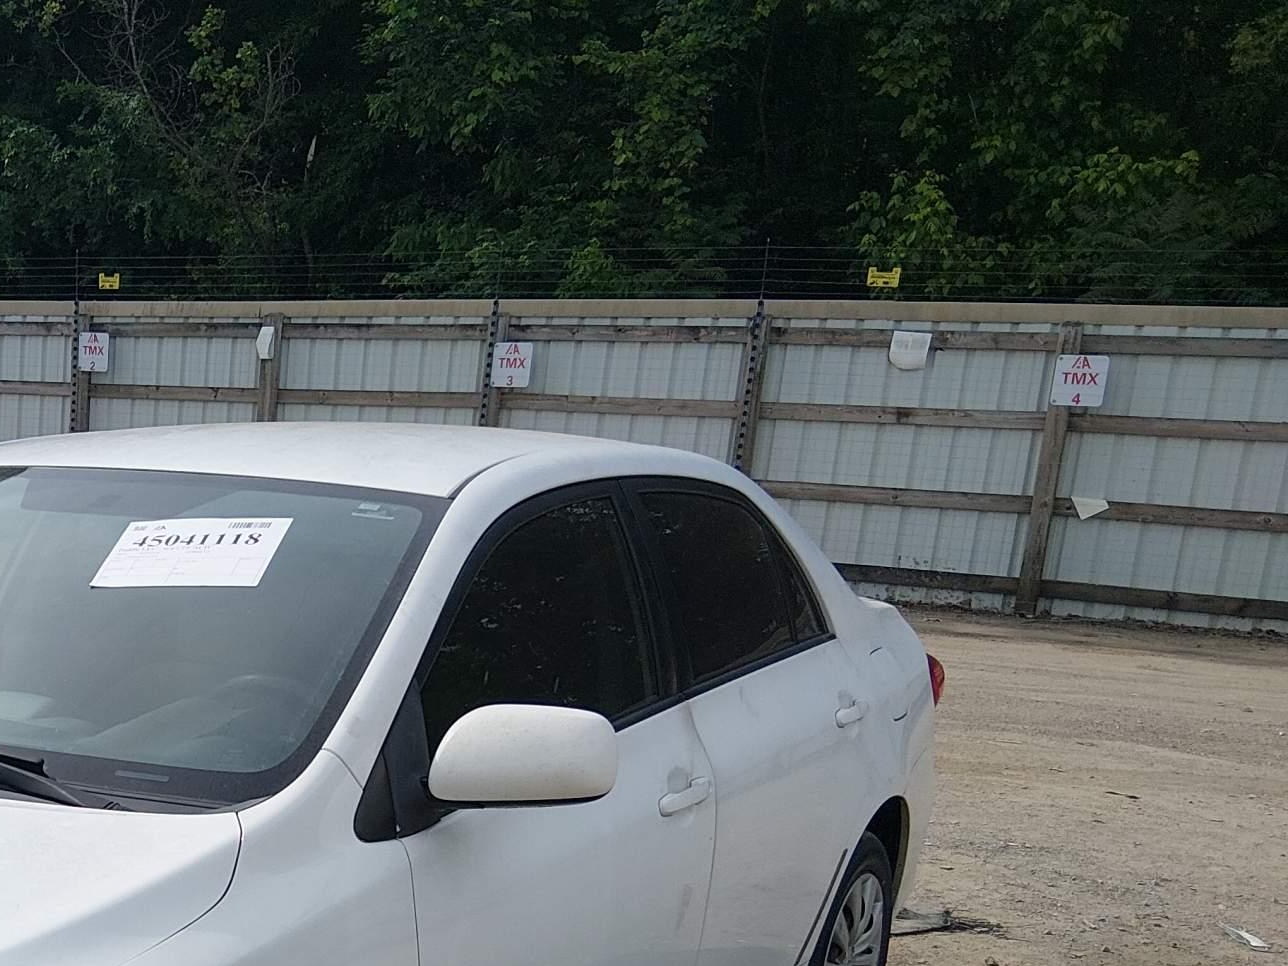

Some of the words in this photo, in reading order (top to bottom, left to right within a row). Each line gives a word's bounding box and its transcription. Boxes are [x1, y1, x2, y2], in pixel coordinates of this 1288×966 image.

[82, 345, 105, 356] TMX
[89, 361, 96, 370] 2
[498, 357, 527, 368] TMX
[506, 375, 514, 386] 3
[1062, 372, 1099, 385] TMX
[1071, 393, 1081, 405] 4
[133, 532, 262, 547] 45041118
